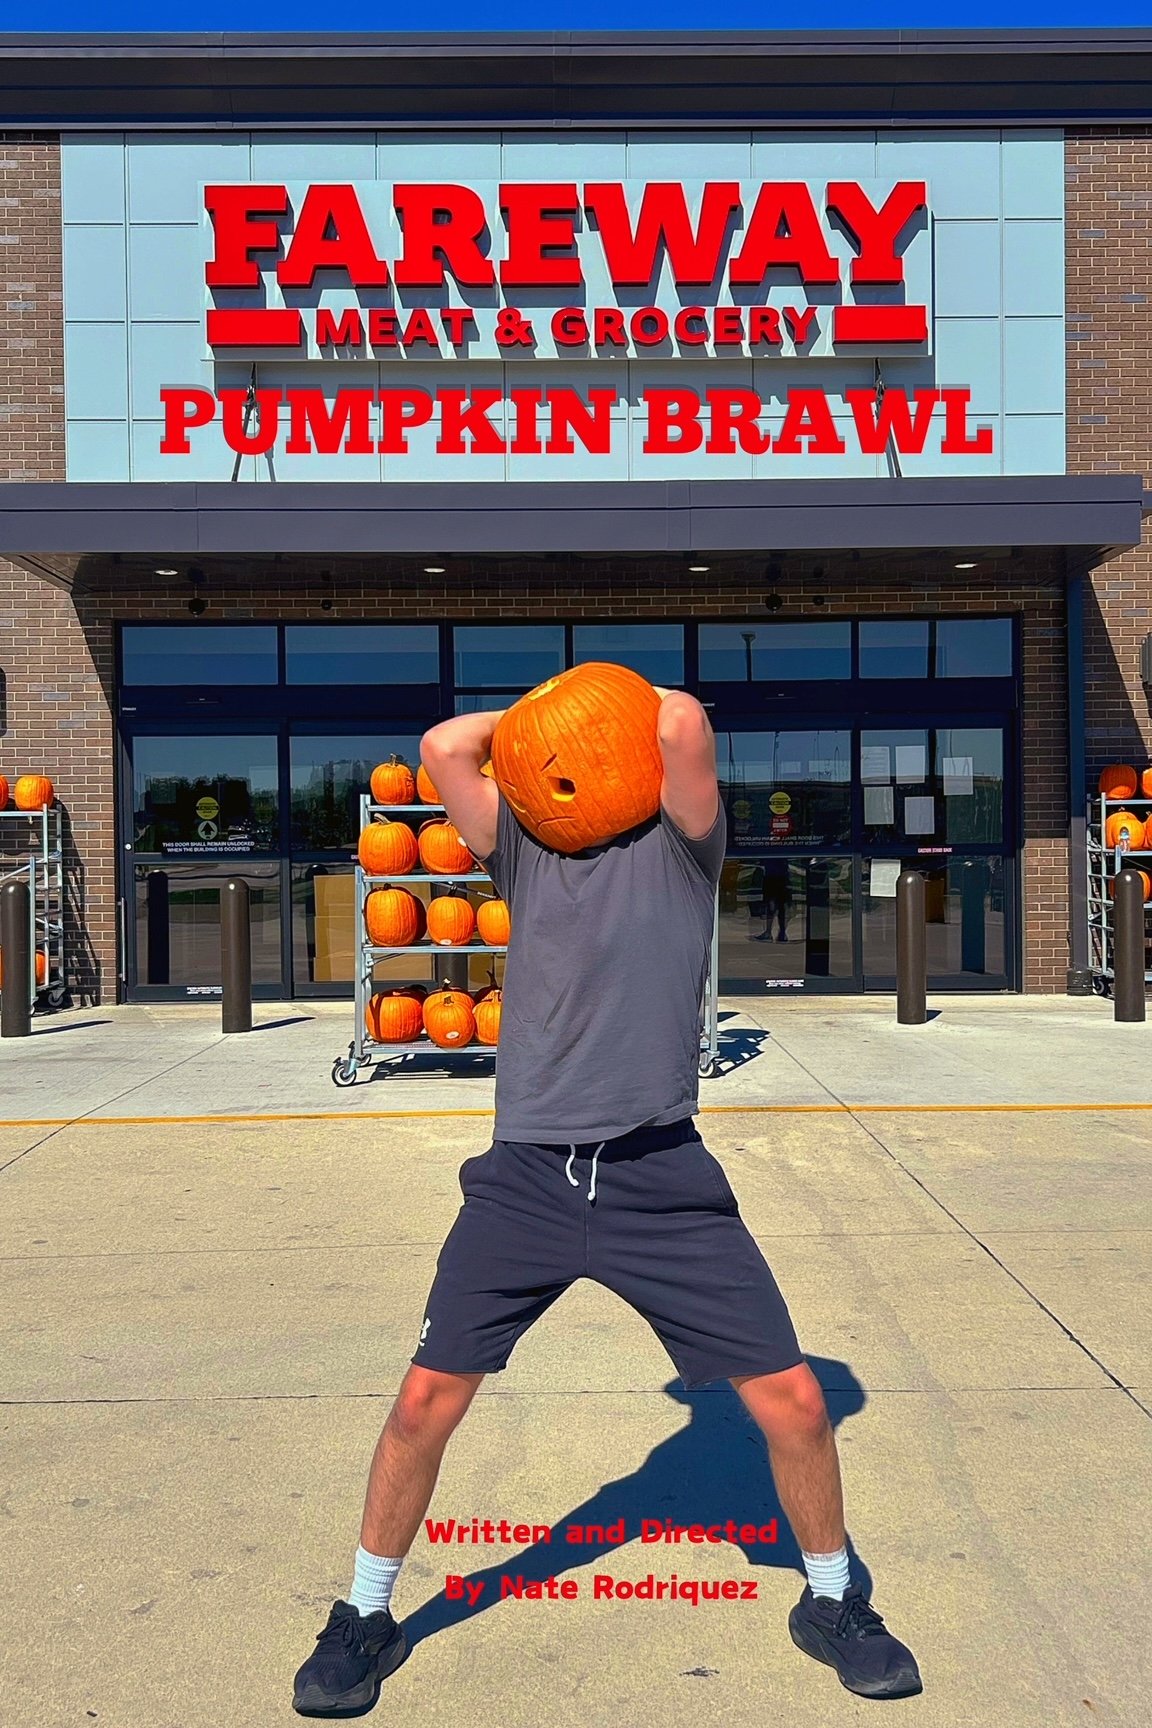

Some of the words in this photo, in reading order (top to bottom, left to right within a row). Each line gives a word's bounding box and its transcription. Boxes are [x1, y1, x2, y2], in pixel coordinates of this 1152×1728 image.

[205, 181, 926, 287] FAREWAY
[316, 307, 474, 345] MEAT
[495, 306, 534, 346] &
[552, 306, 818, 346] GROCERY
